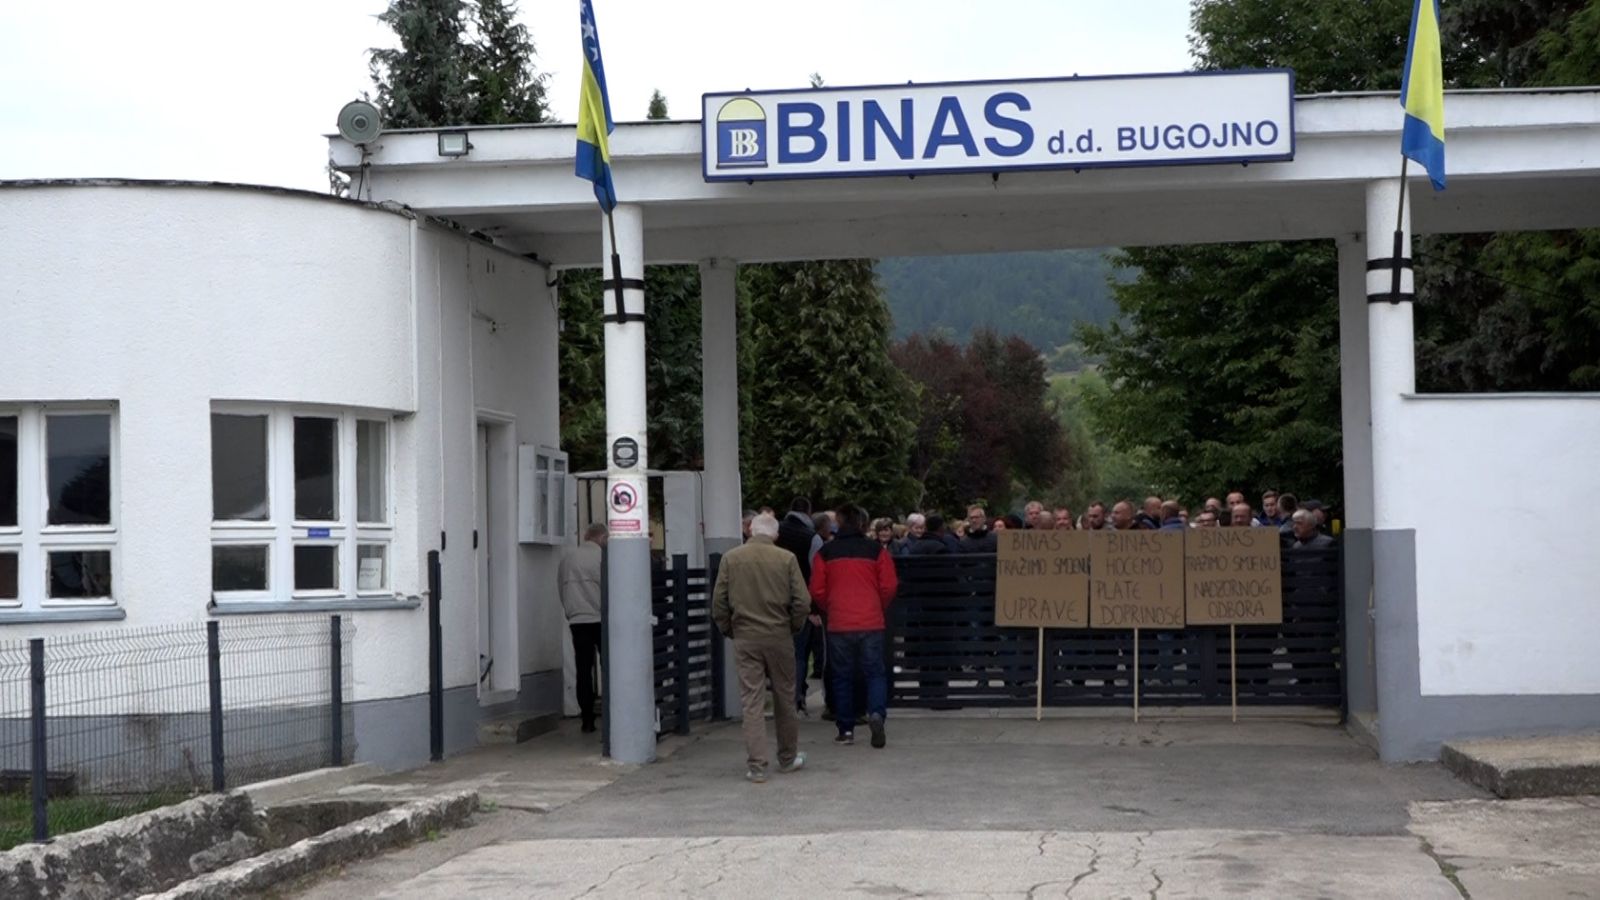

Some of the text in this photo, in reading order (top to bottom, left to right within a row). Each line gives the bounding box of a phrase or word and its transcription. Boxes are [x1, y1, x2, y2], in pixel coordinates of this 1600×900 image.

[777, 92, 1279, 164] BINAS d.d. BUGOJNO
[1095, 580, 1141, 600] PLATE
[1193, 578, 1272, 598] NADZORNOG
[1003, 597, 1079, 622] UPRAVE
[1207, 600, 1265, 618] ODBORA
